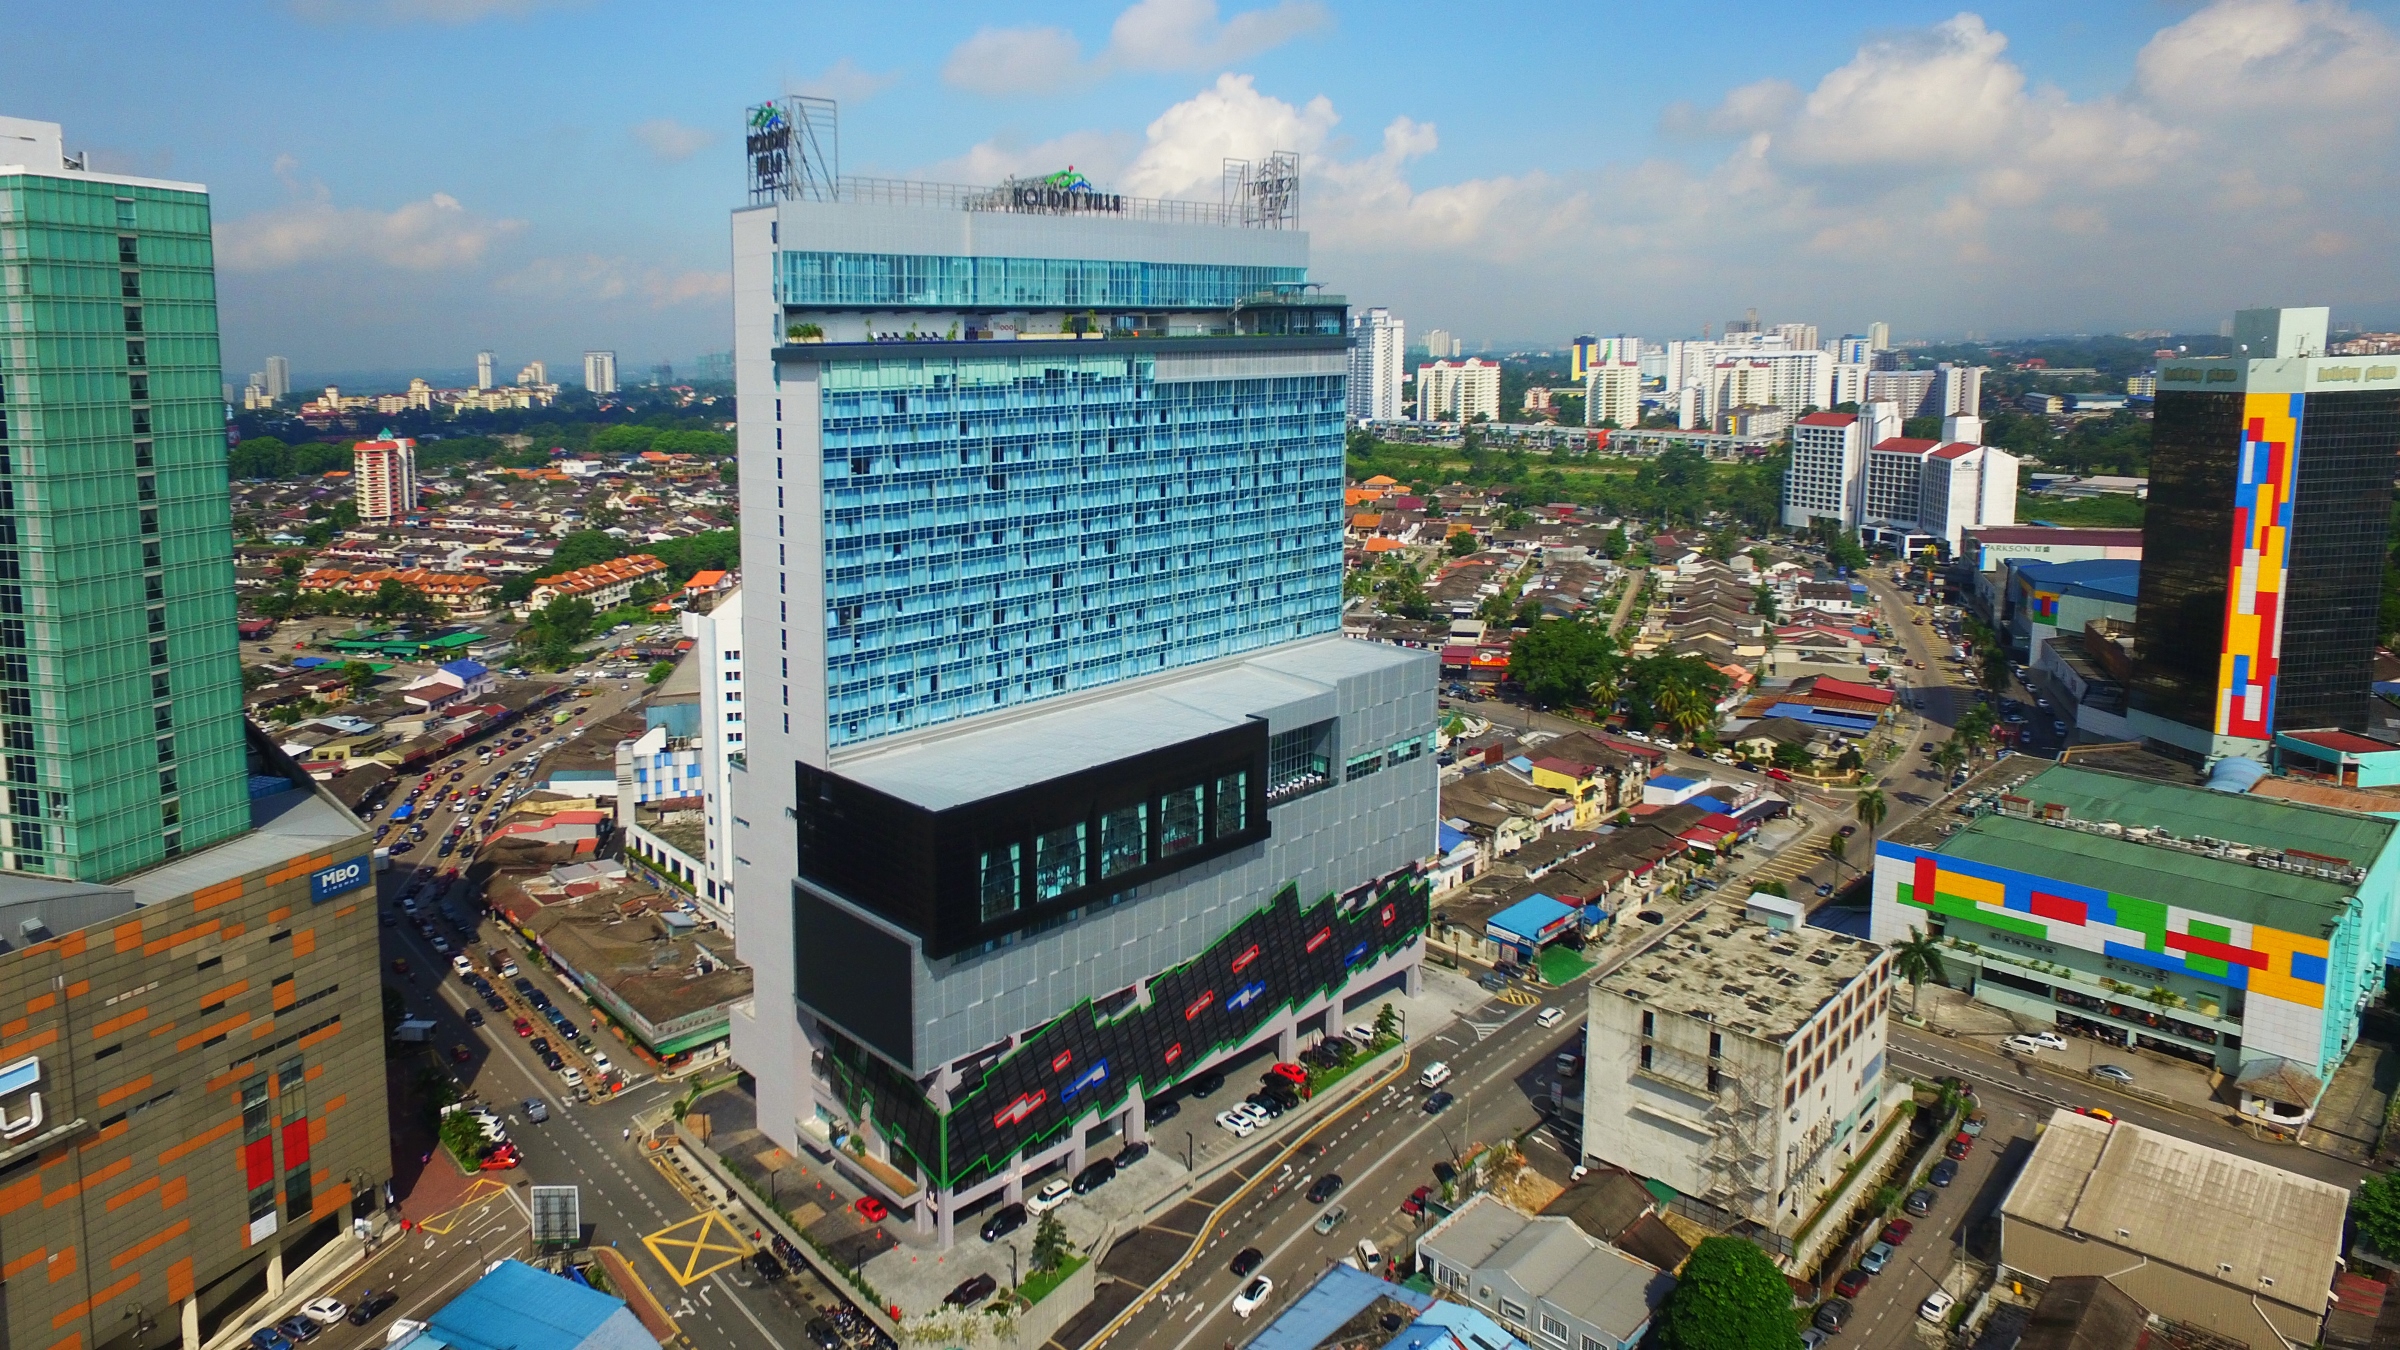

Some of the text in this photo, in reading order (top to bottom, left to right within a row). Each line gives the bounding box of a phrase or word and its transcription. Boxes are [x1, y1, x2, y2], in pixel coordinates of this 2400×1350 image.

[1014, 187, 1120, 211] HOLIDAY VILLA
[1985, 544, 2031, 552] PARKSON
[322, 864, 360, 888] MBO
